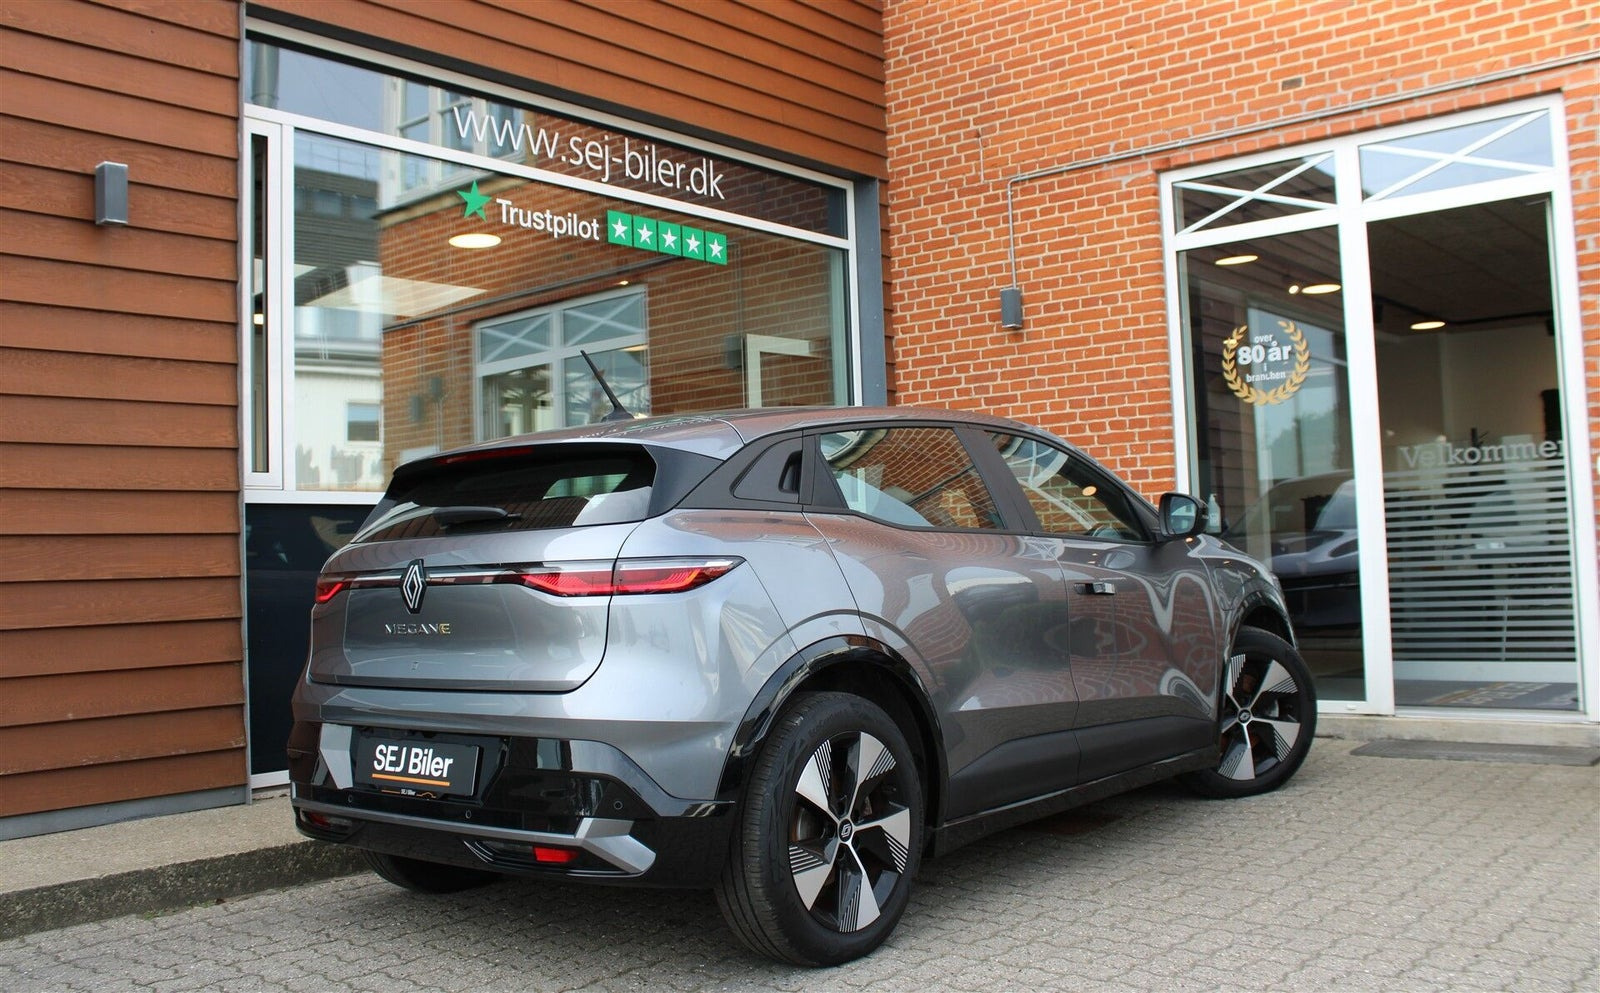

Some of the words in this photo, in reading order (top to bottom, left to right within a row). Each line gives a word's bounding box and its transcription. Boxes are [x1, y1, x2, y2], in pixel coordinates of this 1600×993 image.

[453, 107, 724, 199] www.sej-biler.dk
[496, 198, 600, 240] Trustpilot
[1238, 345, 1265, 365] 80
[1267, 341, 1292, 361] år
[1254, 334, 1273, 343] over
[374, 744, 407, 773] SEJ
[408, 747, 453, 777] Biler
